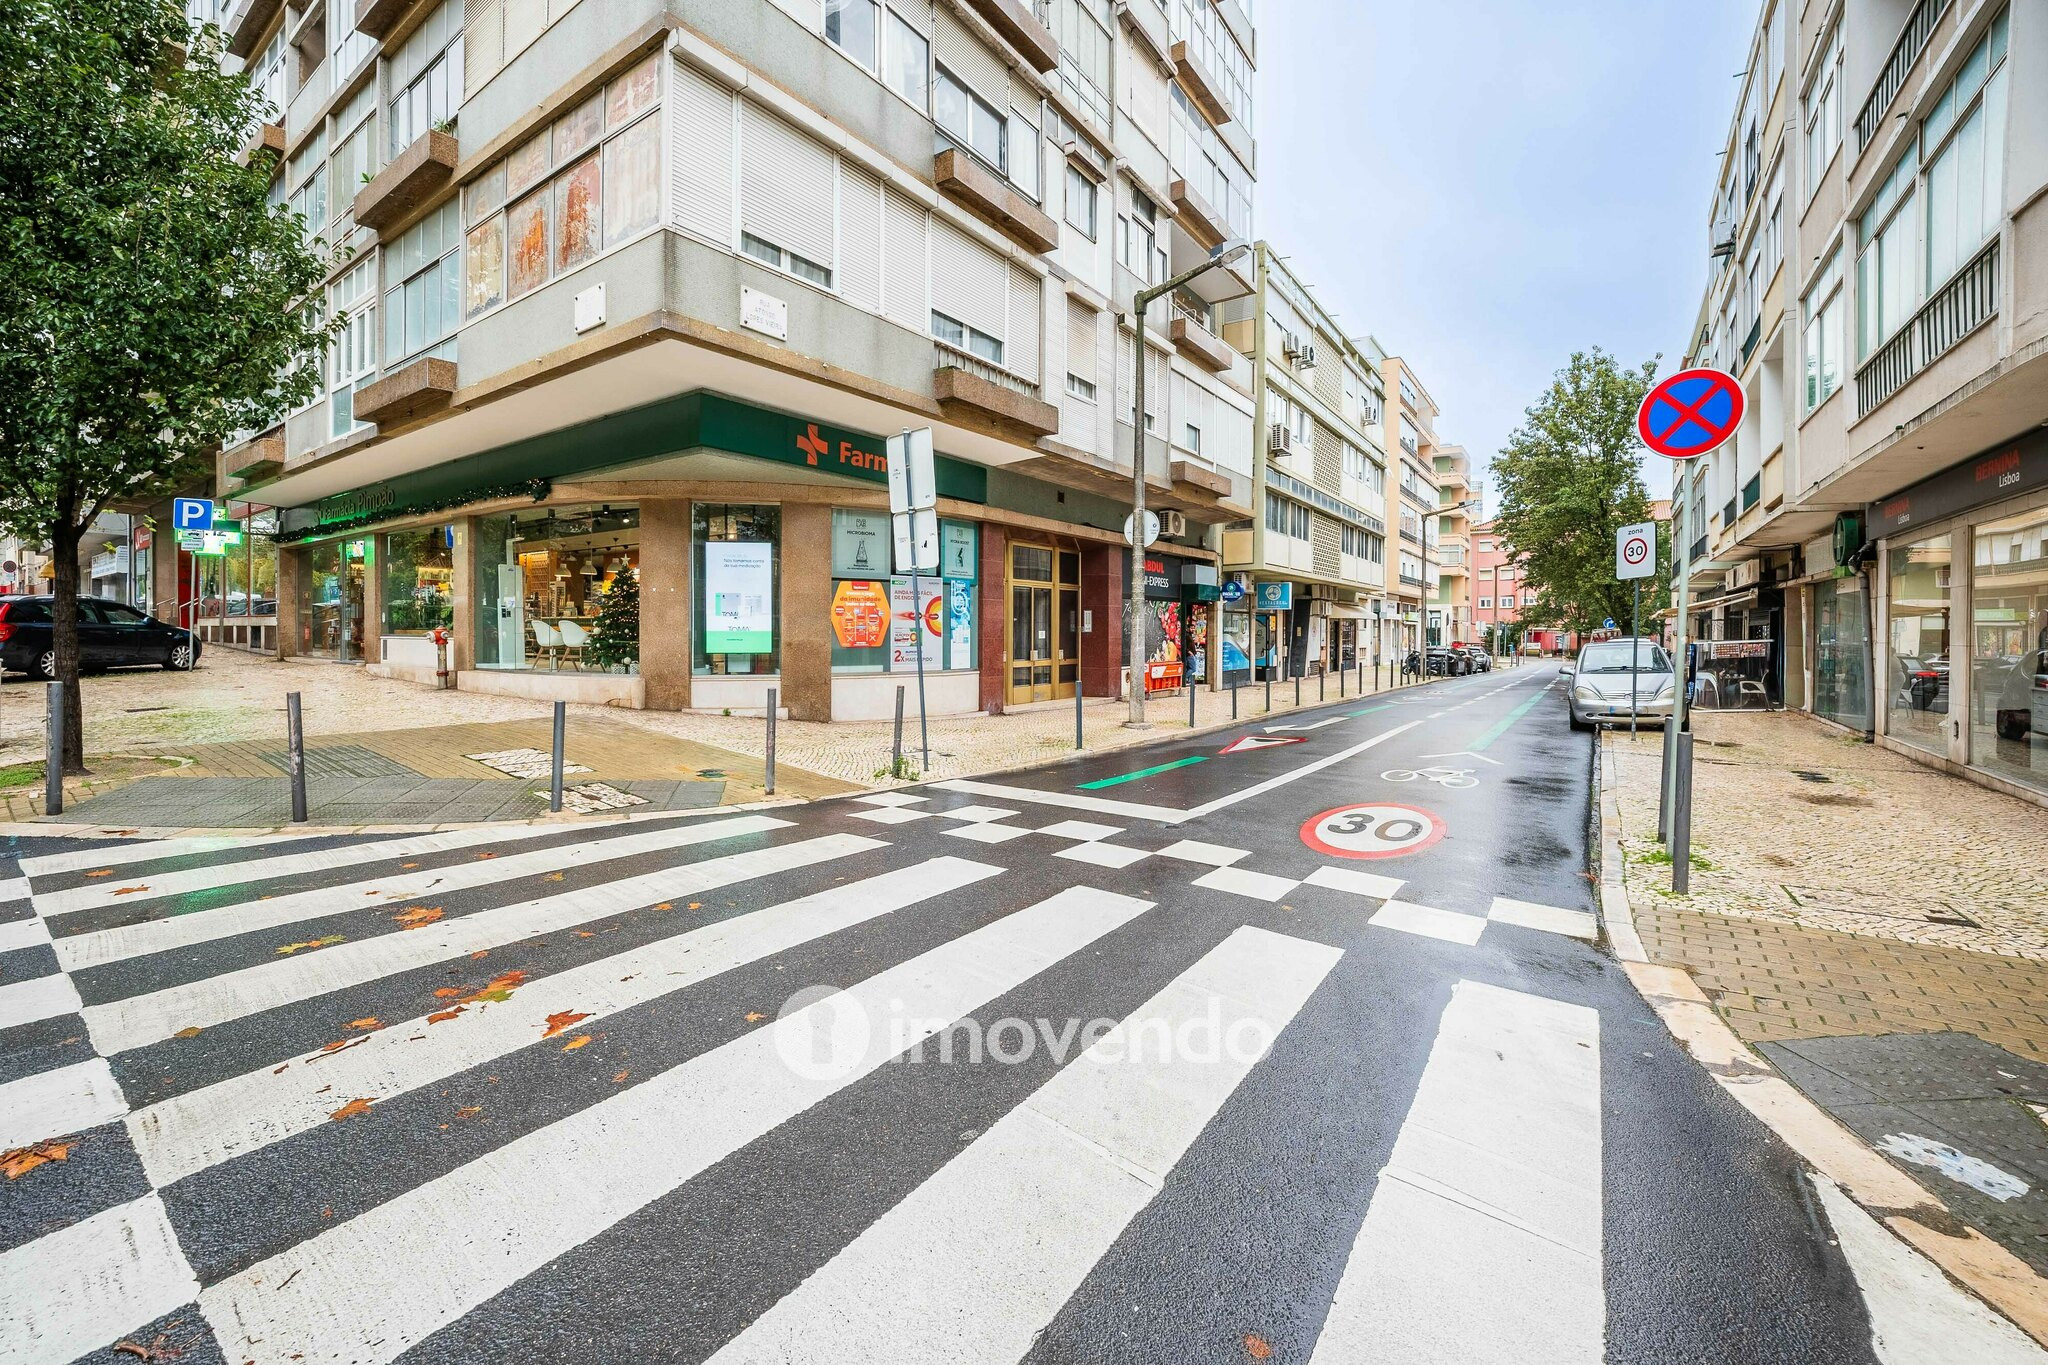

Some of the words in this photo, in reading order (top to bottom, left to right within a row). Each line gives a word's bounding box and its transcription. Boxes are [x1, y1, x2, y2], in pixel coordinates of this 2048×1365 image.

[1975, 449, 2020, 482] BERNINA
[1998, 471, 2020, 488] Lisboa
[357, 485, 395, 513] Pimpão
[182, 502, 205, 527] P
[1897, 513, 1910, 525] Lisboa
[1628, 546, 1643, 557] 30
[1144, 559, 1165, 575] ABDUL
[1143, 575, 1169, 588] I-EXPRESS
[1327, 813, 1424, 842] 30
